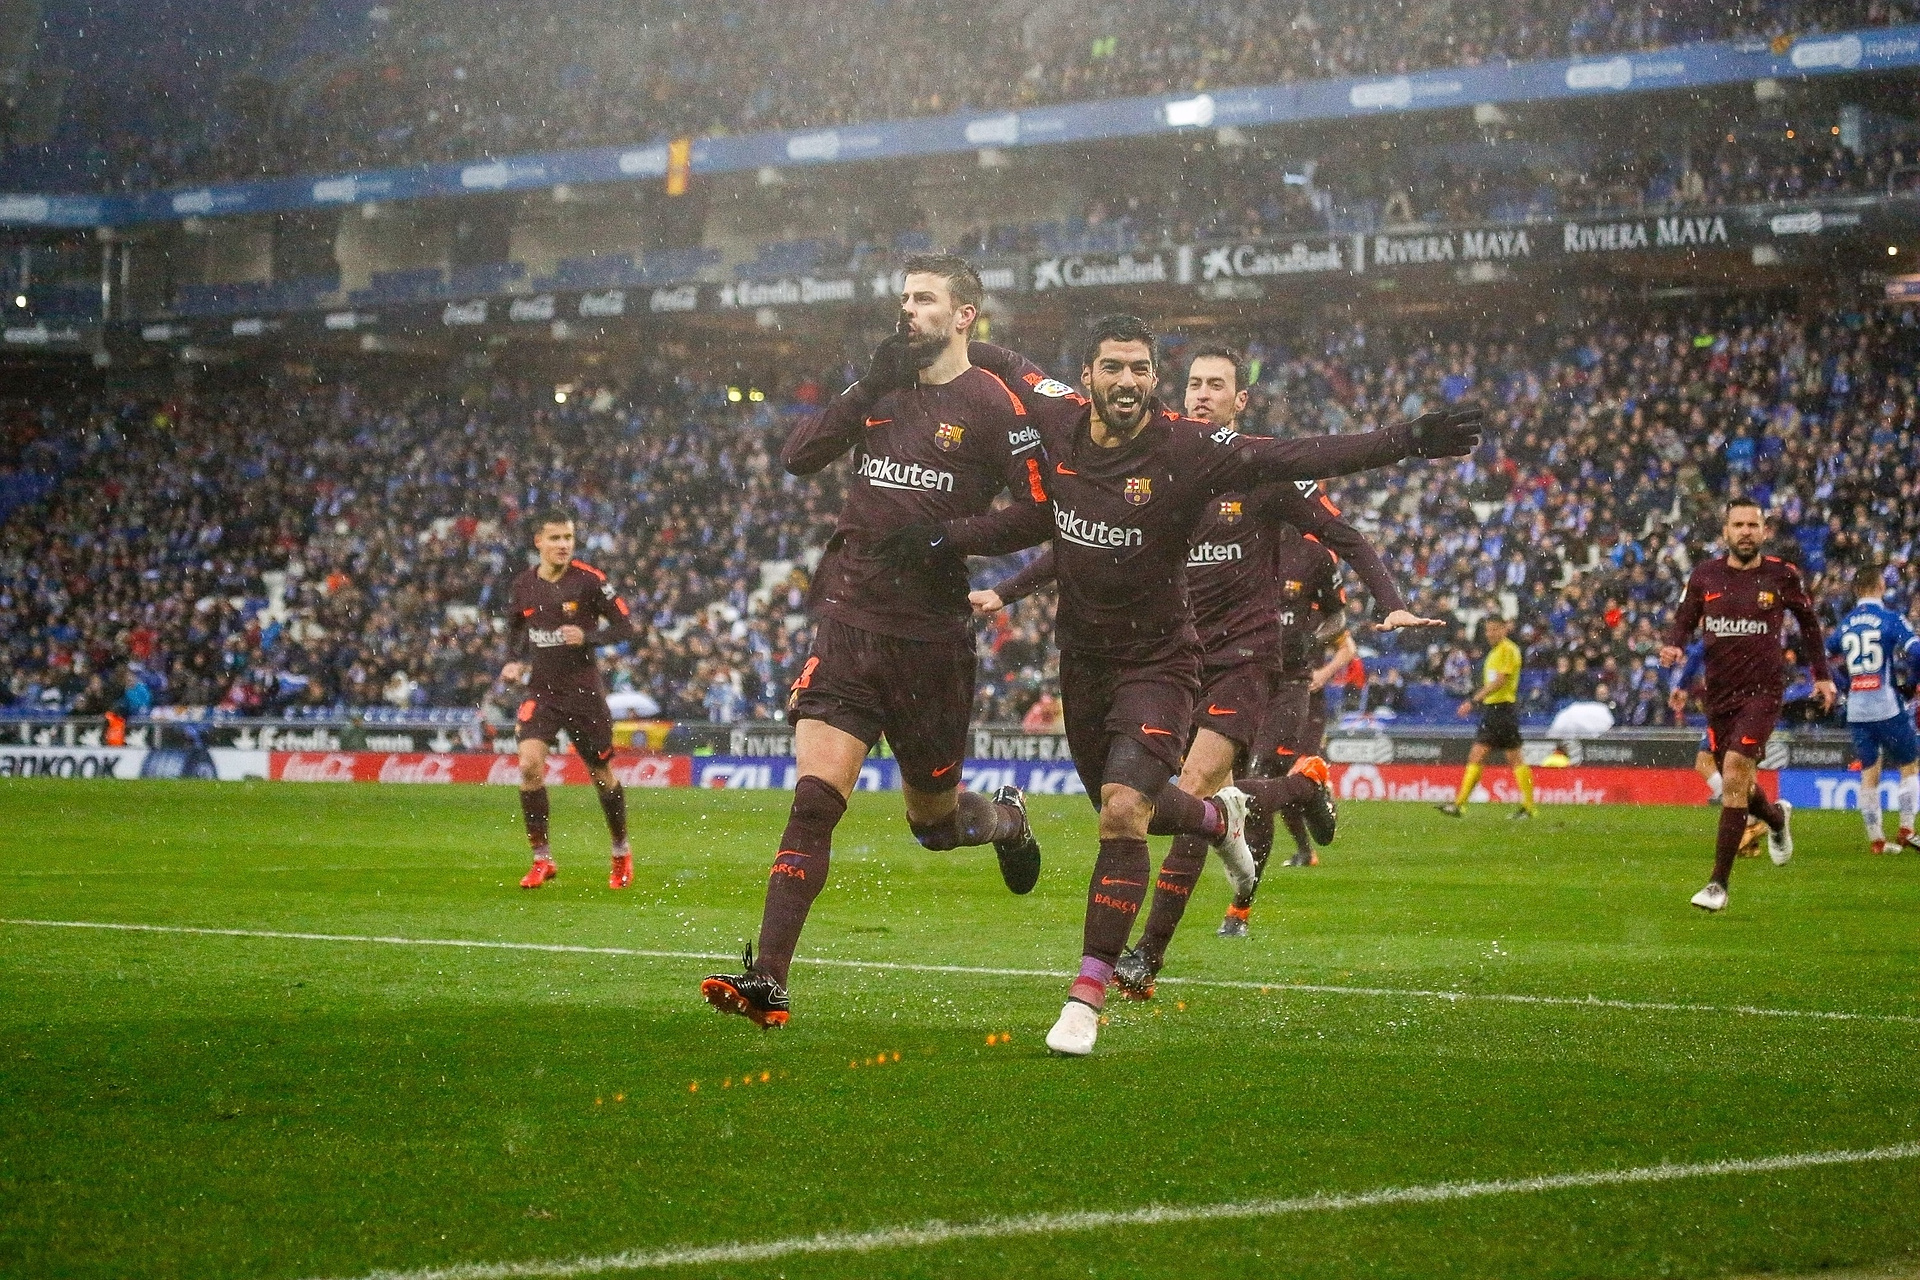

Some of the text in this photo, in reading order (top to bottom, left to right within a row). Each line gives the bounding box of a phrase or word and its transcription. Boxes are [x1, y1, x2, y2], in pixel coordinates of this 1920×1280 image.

[1462, 230, 1530, 259] MAYA
[1656, 216, 1728, 247] MAYA
[858, 453, 953, 491] Rakuten
[1705, 616, 1768, 637] Rakuten
[1841, 629, 1884, 675] 25
